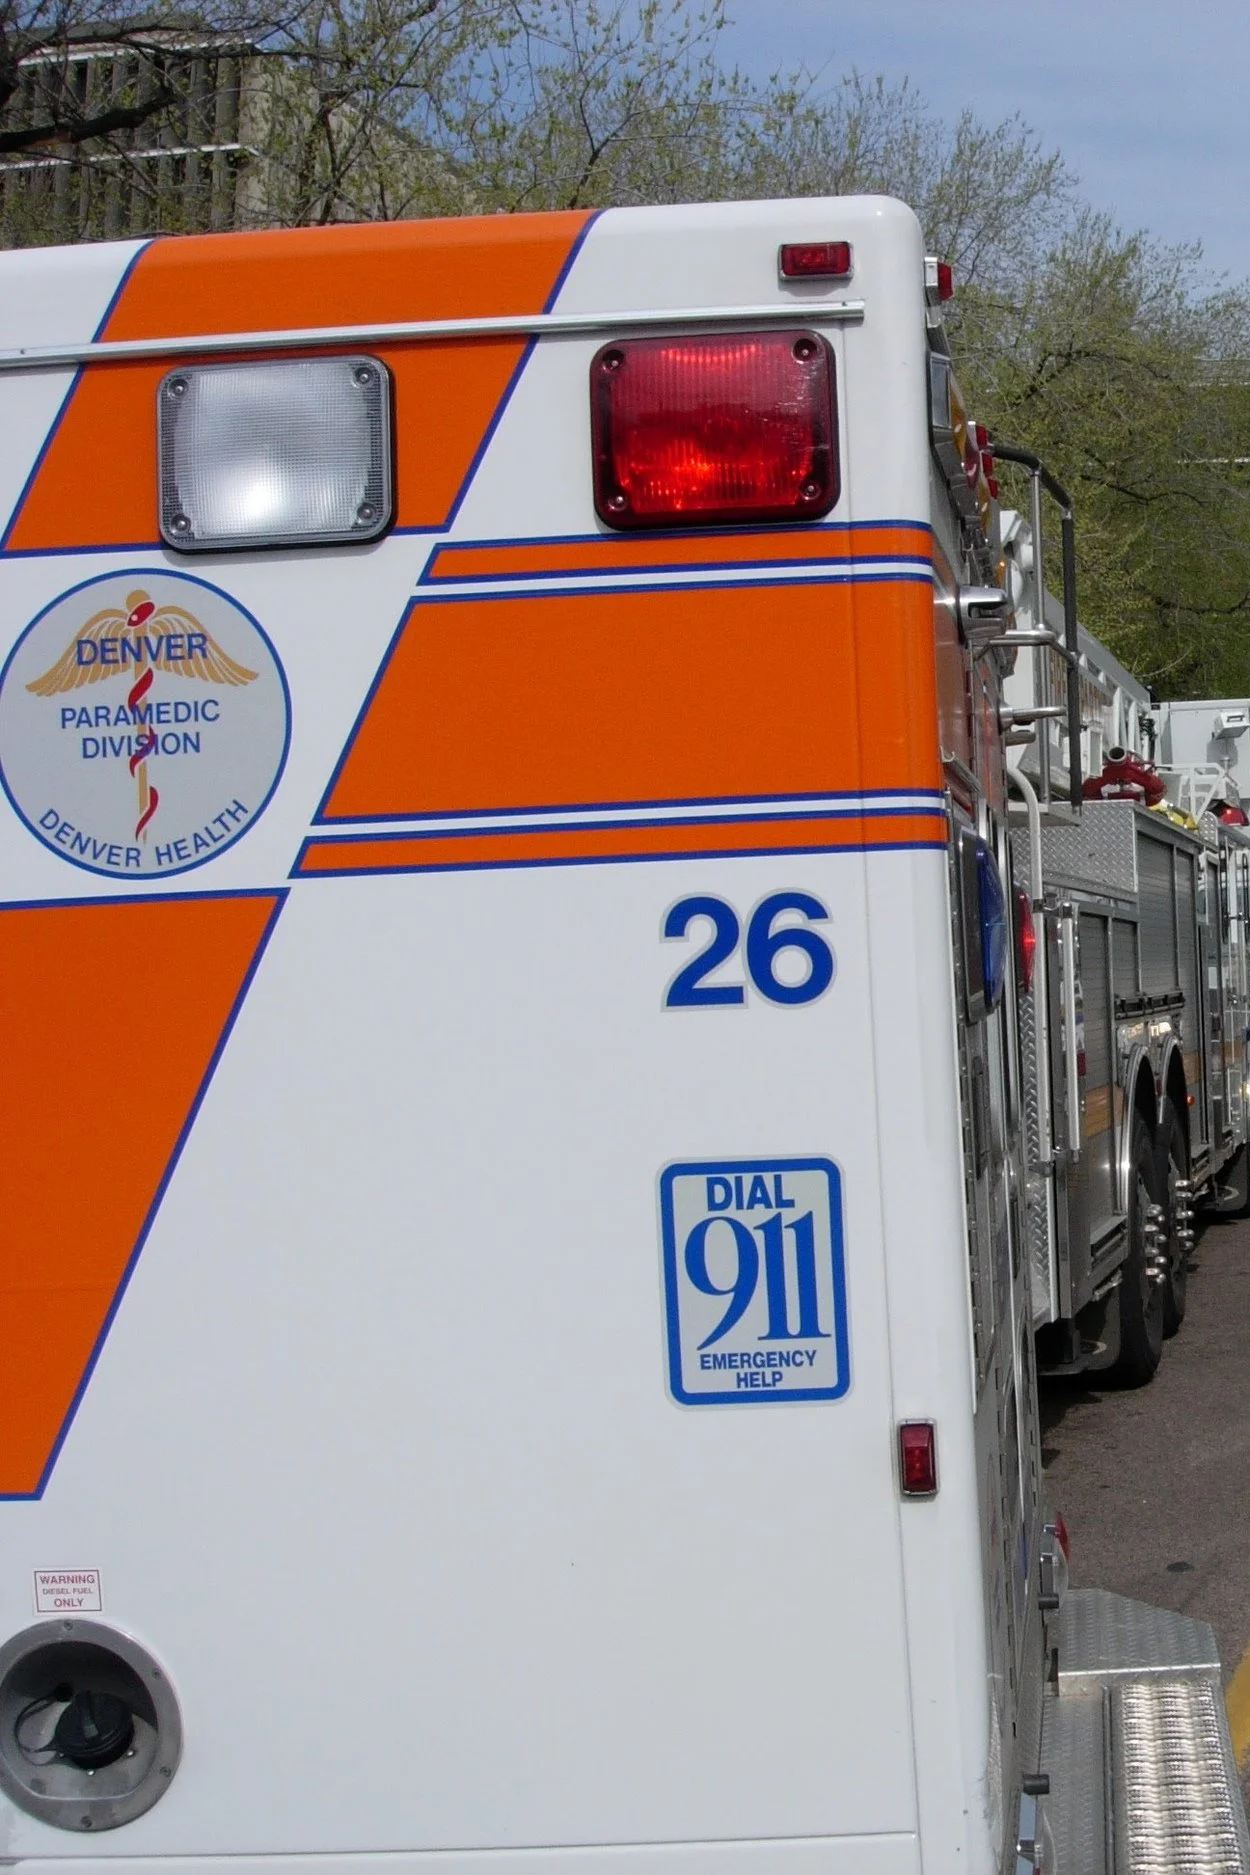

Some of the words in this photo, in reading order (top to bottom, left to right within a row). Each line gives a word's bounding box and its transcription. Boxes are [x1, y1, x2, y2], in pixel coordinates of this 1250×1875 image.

[76, 632, 208, 667] DENVER
[60, 699, 221, 730] PARAMEDIC
[82, 732, 201, 759] DIVISION
[39, 808, 142, 868] DENVER
[155, 799, 249, 866] HEALTH
[663, 891, 834, 1007] 26
[706, 1174, 795, 1211] DIAL
[684, 1210, 832, 1350] 911
[700, 1350, 817, 1370] EMERGENCY
[736, 1371, 783, 1388] HELP
[40, 1574, 95, 1584] WARNING
[54, 1598, 84, 1607] ONLY
